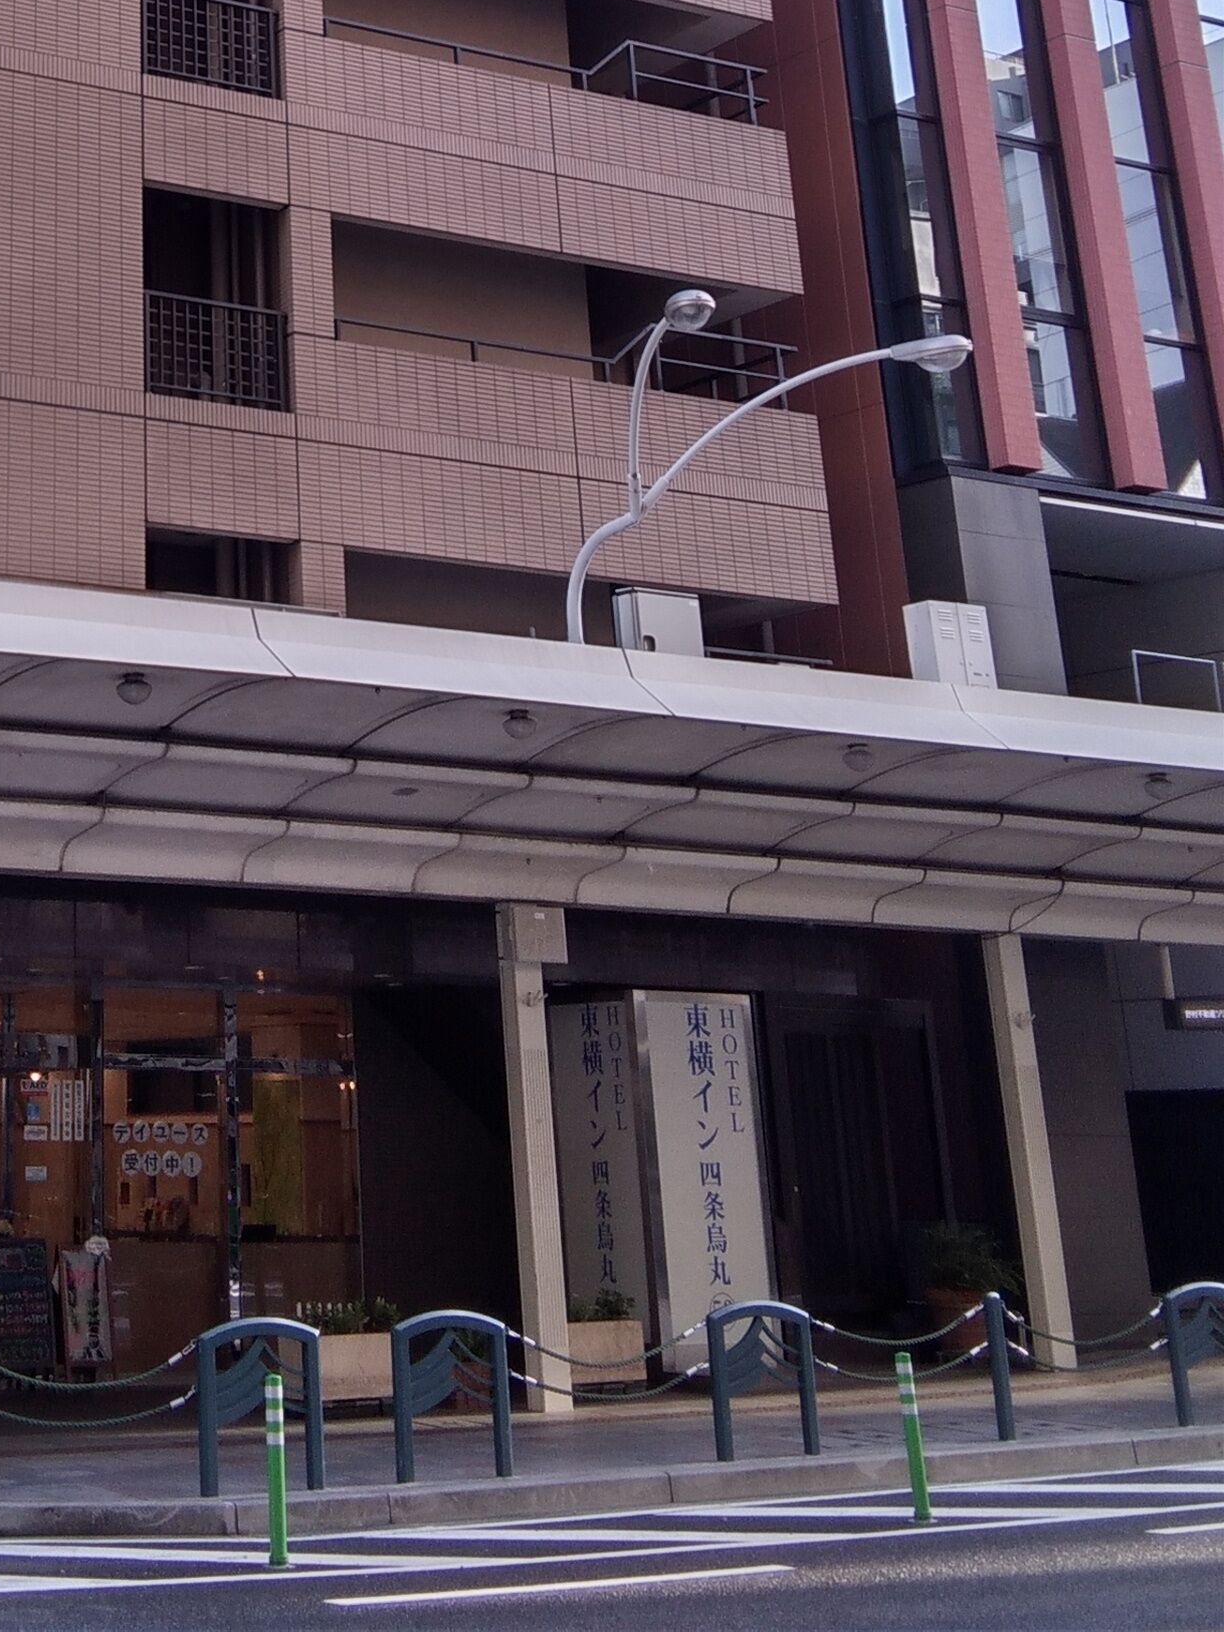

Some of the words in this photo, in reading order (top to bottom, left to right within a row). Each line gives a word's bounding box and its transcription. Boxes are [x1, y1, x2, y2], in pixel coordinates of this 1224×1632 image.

[580, 1003, 606, 1149] 東横イン
[606, 1005, 628, 1131] HOTEL
[684, 1003, 719, 1150] 東横イン
[719, 1008, 745, 1133] HOTEL
[114, 1125, 207, 1142] デイユース
[591, 1160, 618, 1284] 四条烏丸
[699, 1161, 731, 1286] 四条烏丸
